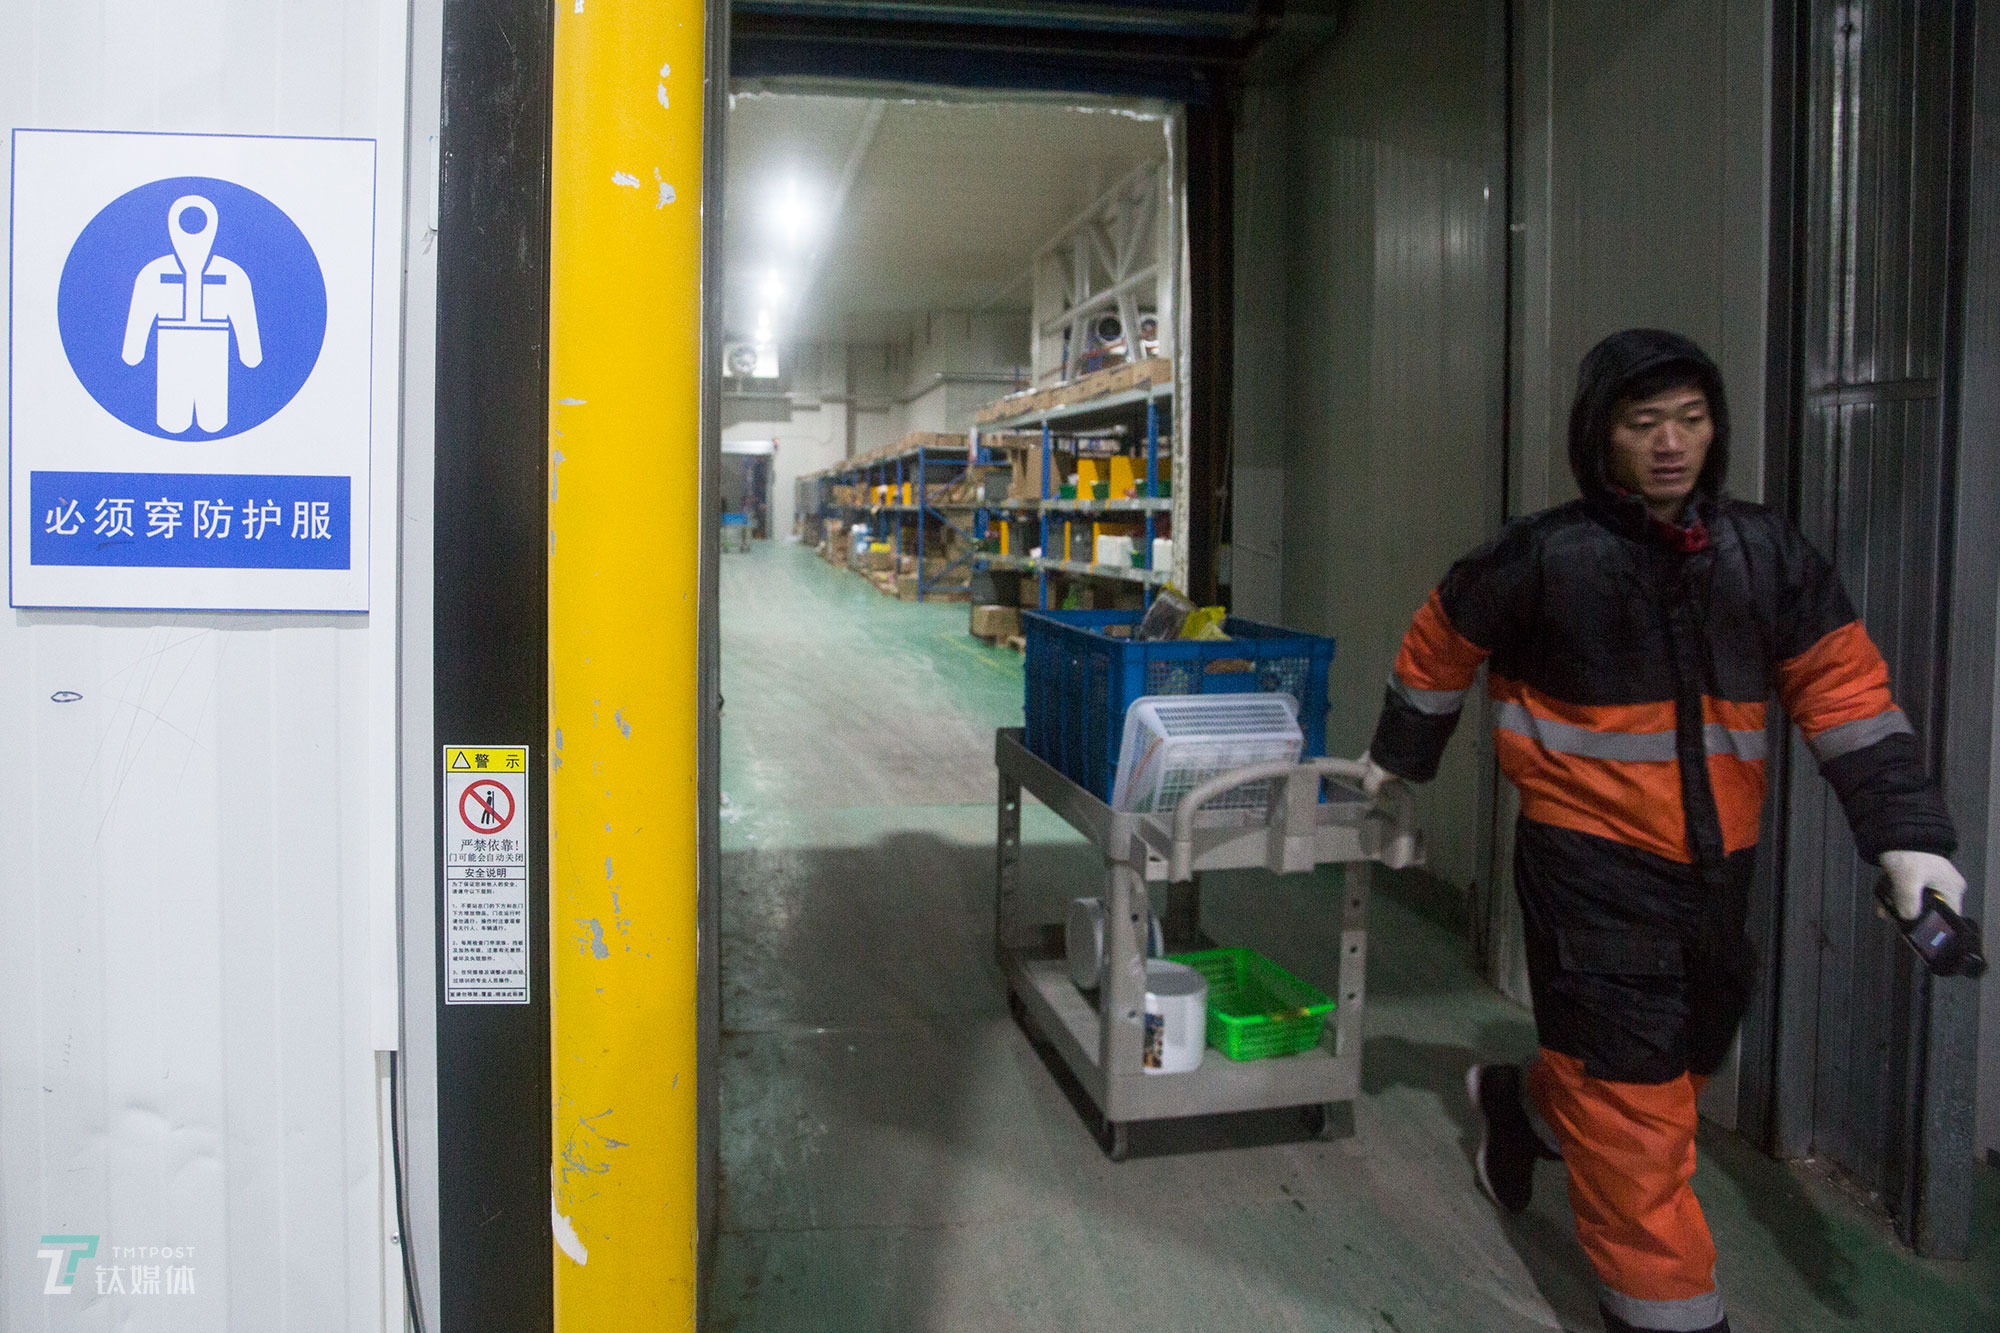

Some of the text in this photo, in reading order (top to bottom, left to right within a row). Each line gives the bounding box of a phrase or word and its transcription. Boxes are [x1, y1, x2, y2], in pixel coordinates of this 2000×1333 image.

[45, 497, 332, 540] 必须穿防护服
[475, 753, 520, 768] 警示
[449, 853, 524, 862] 门可能会自动关闭
[465, 868, 507, 878] 安全说明
